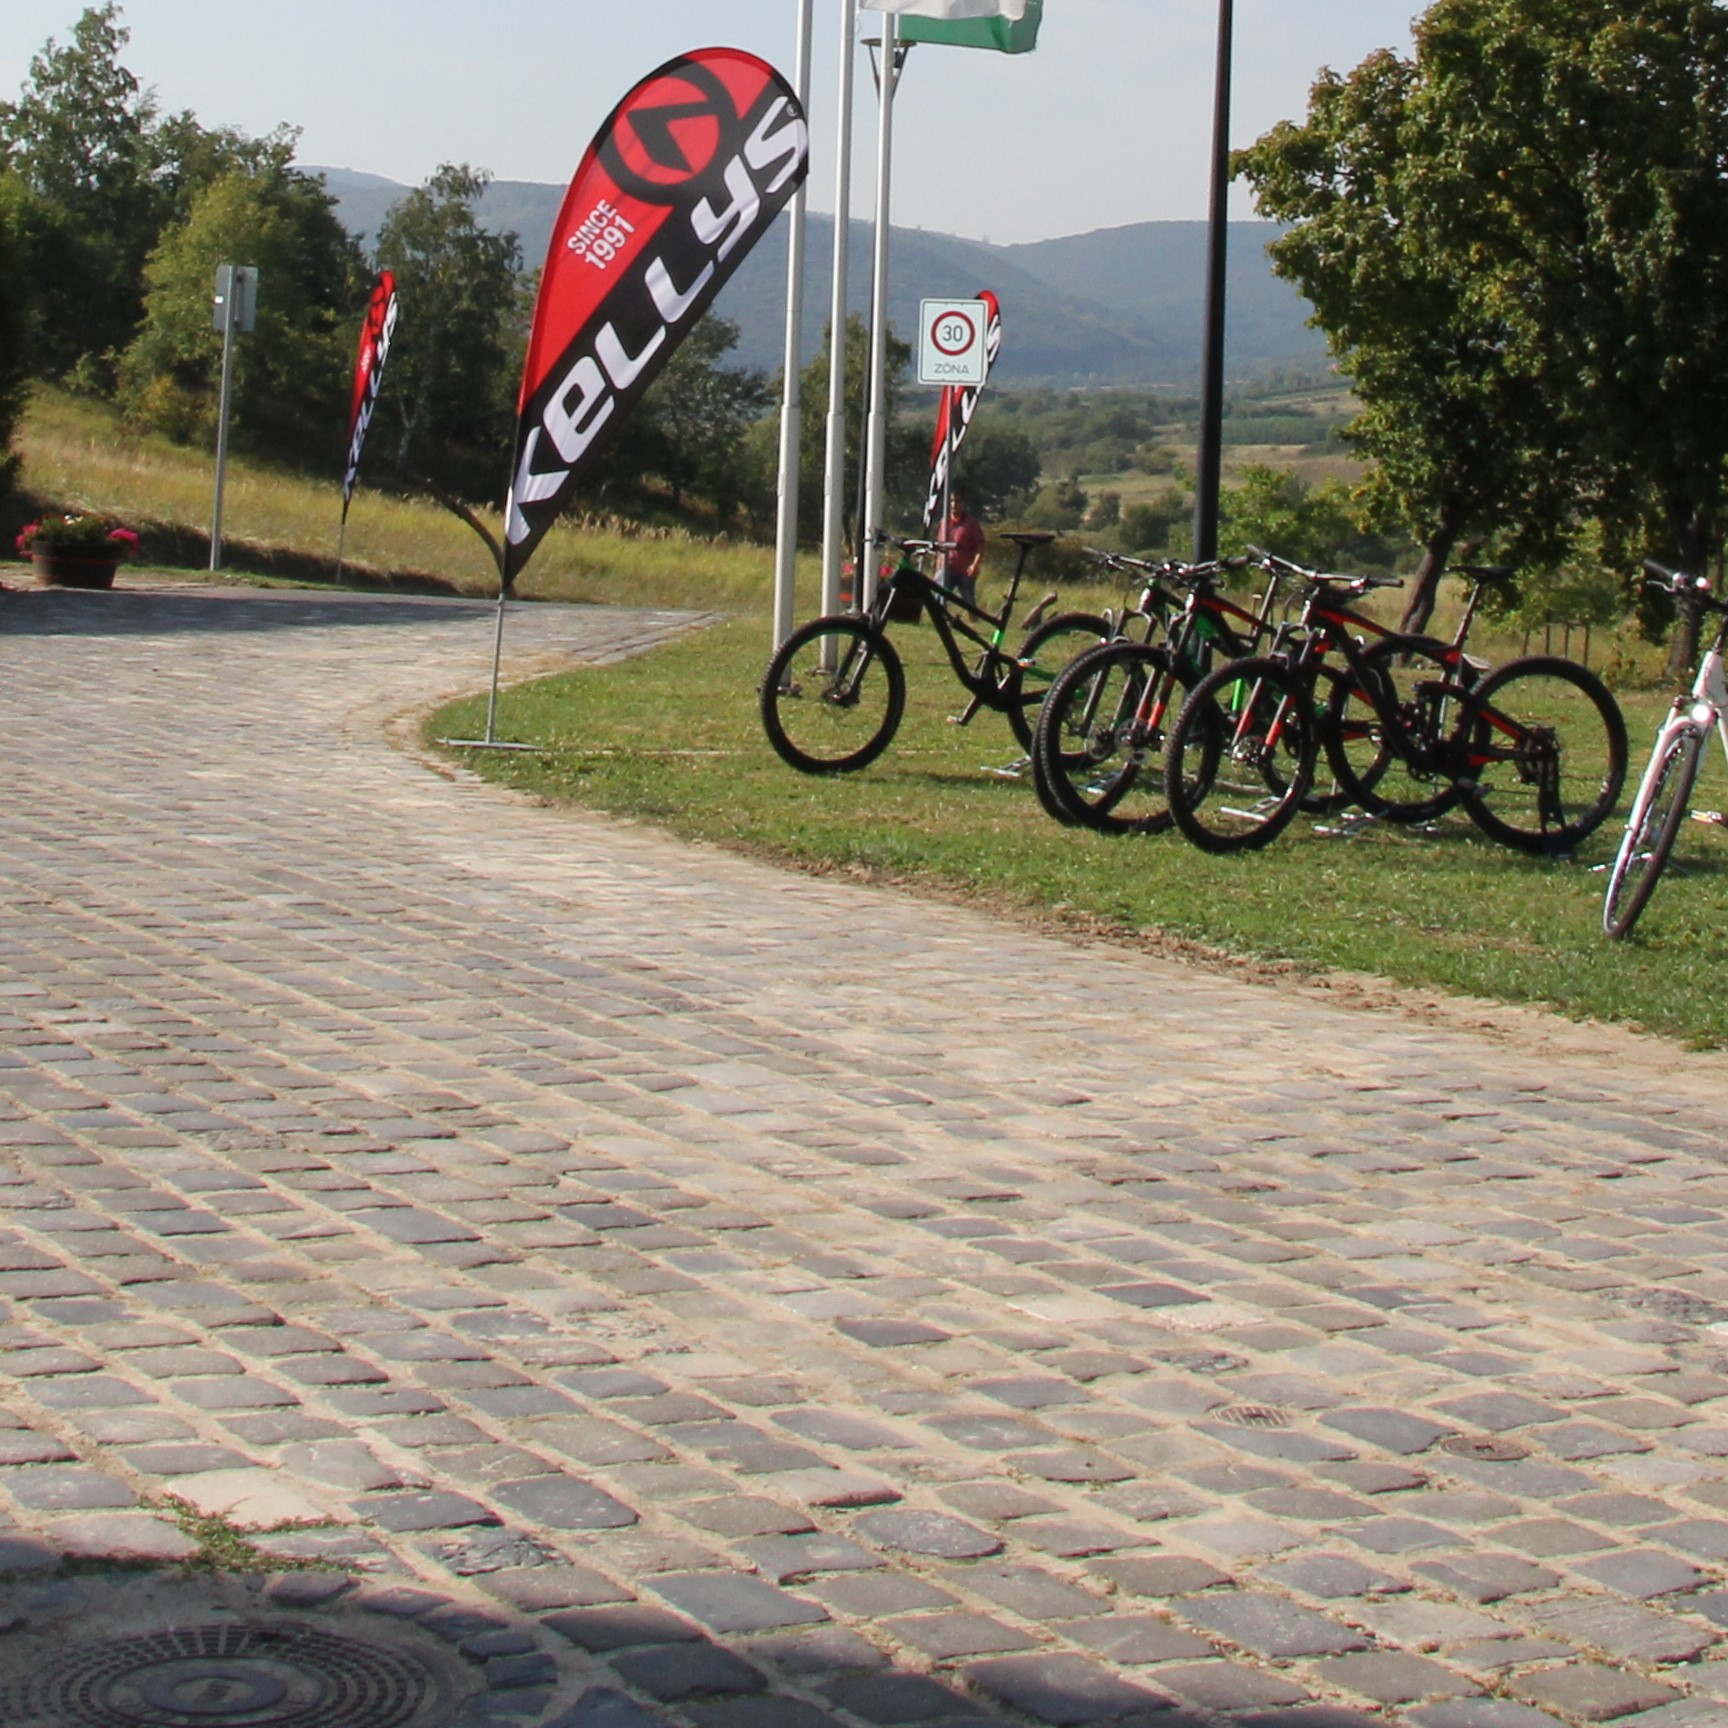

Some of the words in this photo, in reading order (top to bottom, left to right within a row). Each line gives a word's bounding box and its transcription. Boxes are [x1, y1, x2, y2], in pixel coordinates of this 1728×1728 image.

[567, 198, 618, 255] SINCE
[584, 214, 635, 270] 1991
[941, 324, 964, 343] 30
[933, 360, 970, 374] ZÓNA
